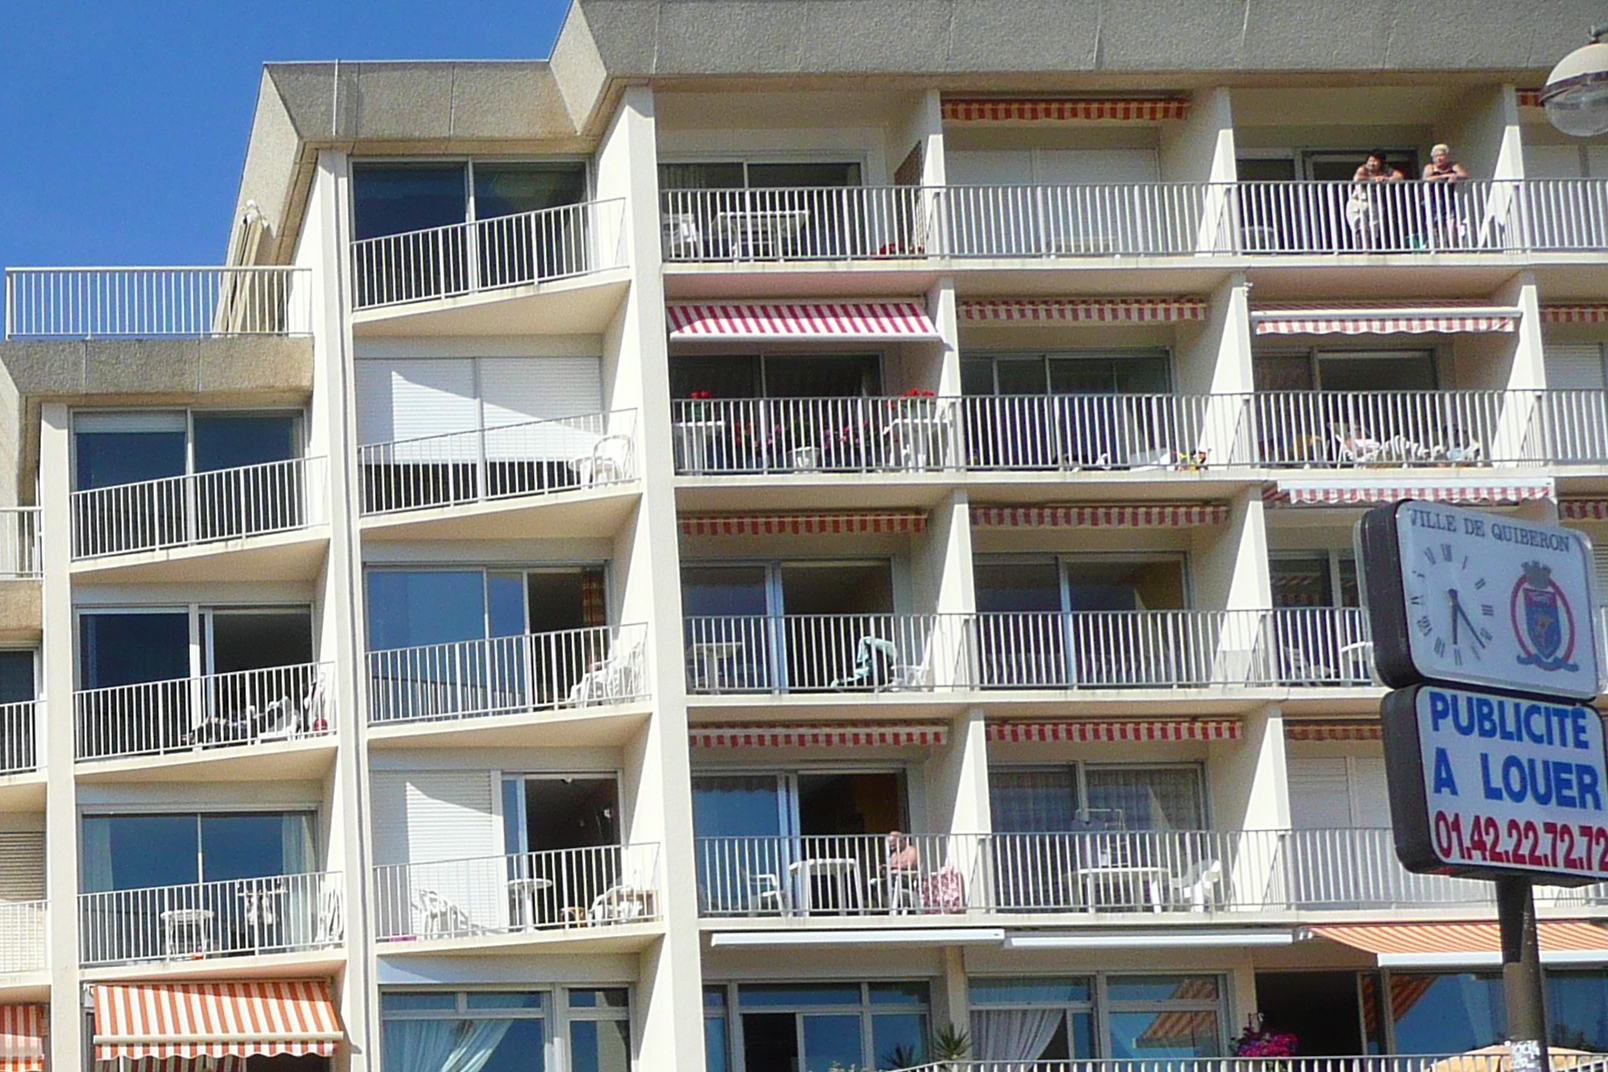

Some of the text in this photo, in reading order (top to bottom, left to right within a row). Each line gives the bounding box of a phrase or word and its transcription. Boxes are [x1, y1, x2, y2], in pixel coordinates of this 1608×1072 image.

[1408, 508, 1570, 553] VILLE DE QUIBERON
[1429, 691, 1589, 750] PUBLICITÉ
[1434, 747, 1603, 811] A LOUER
[1434, 810, 1608, 873] 01.42.22.72.72
